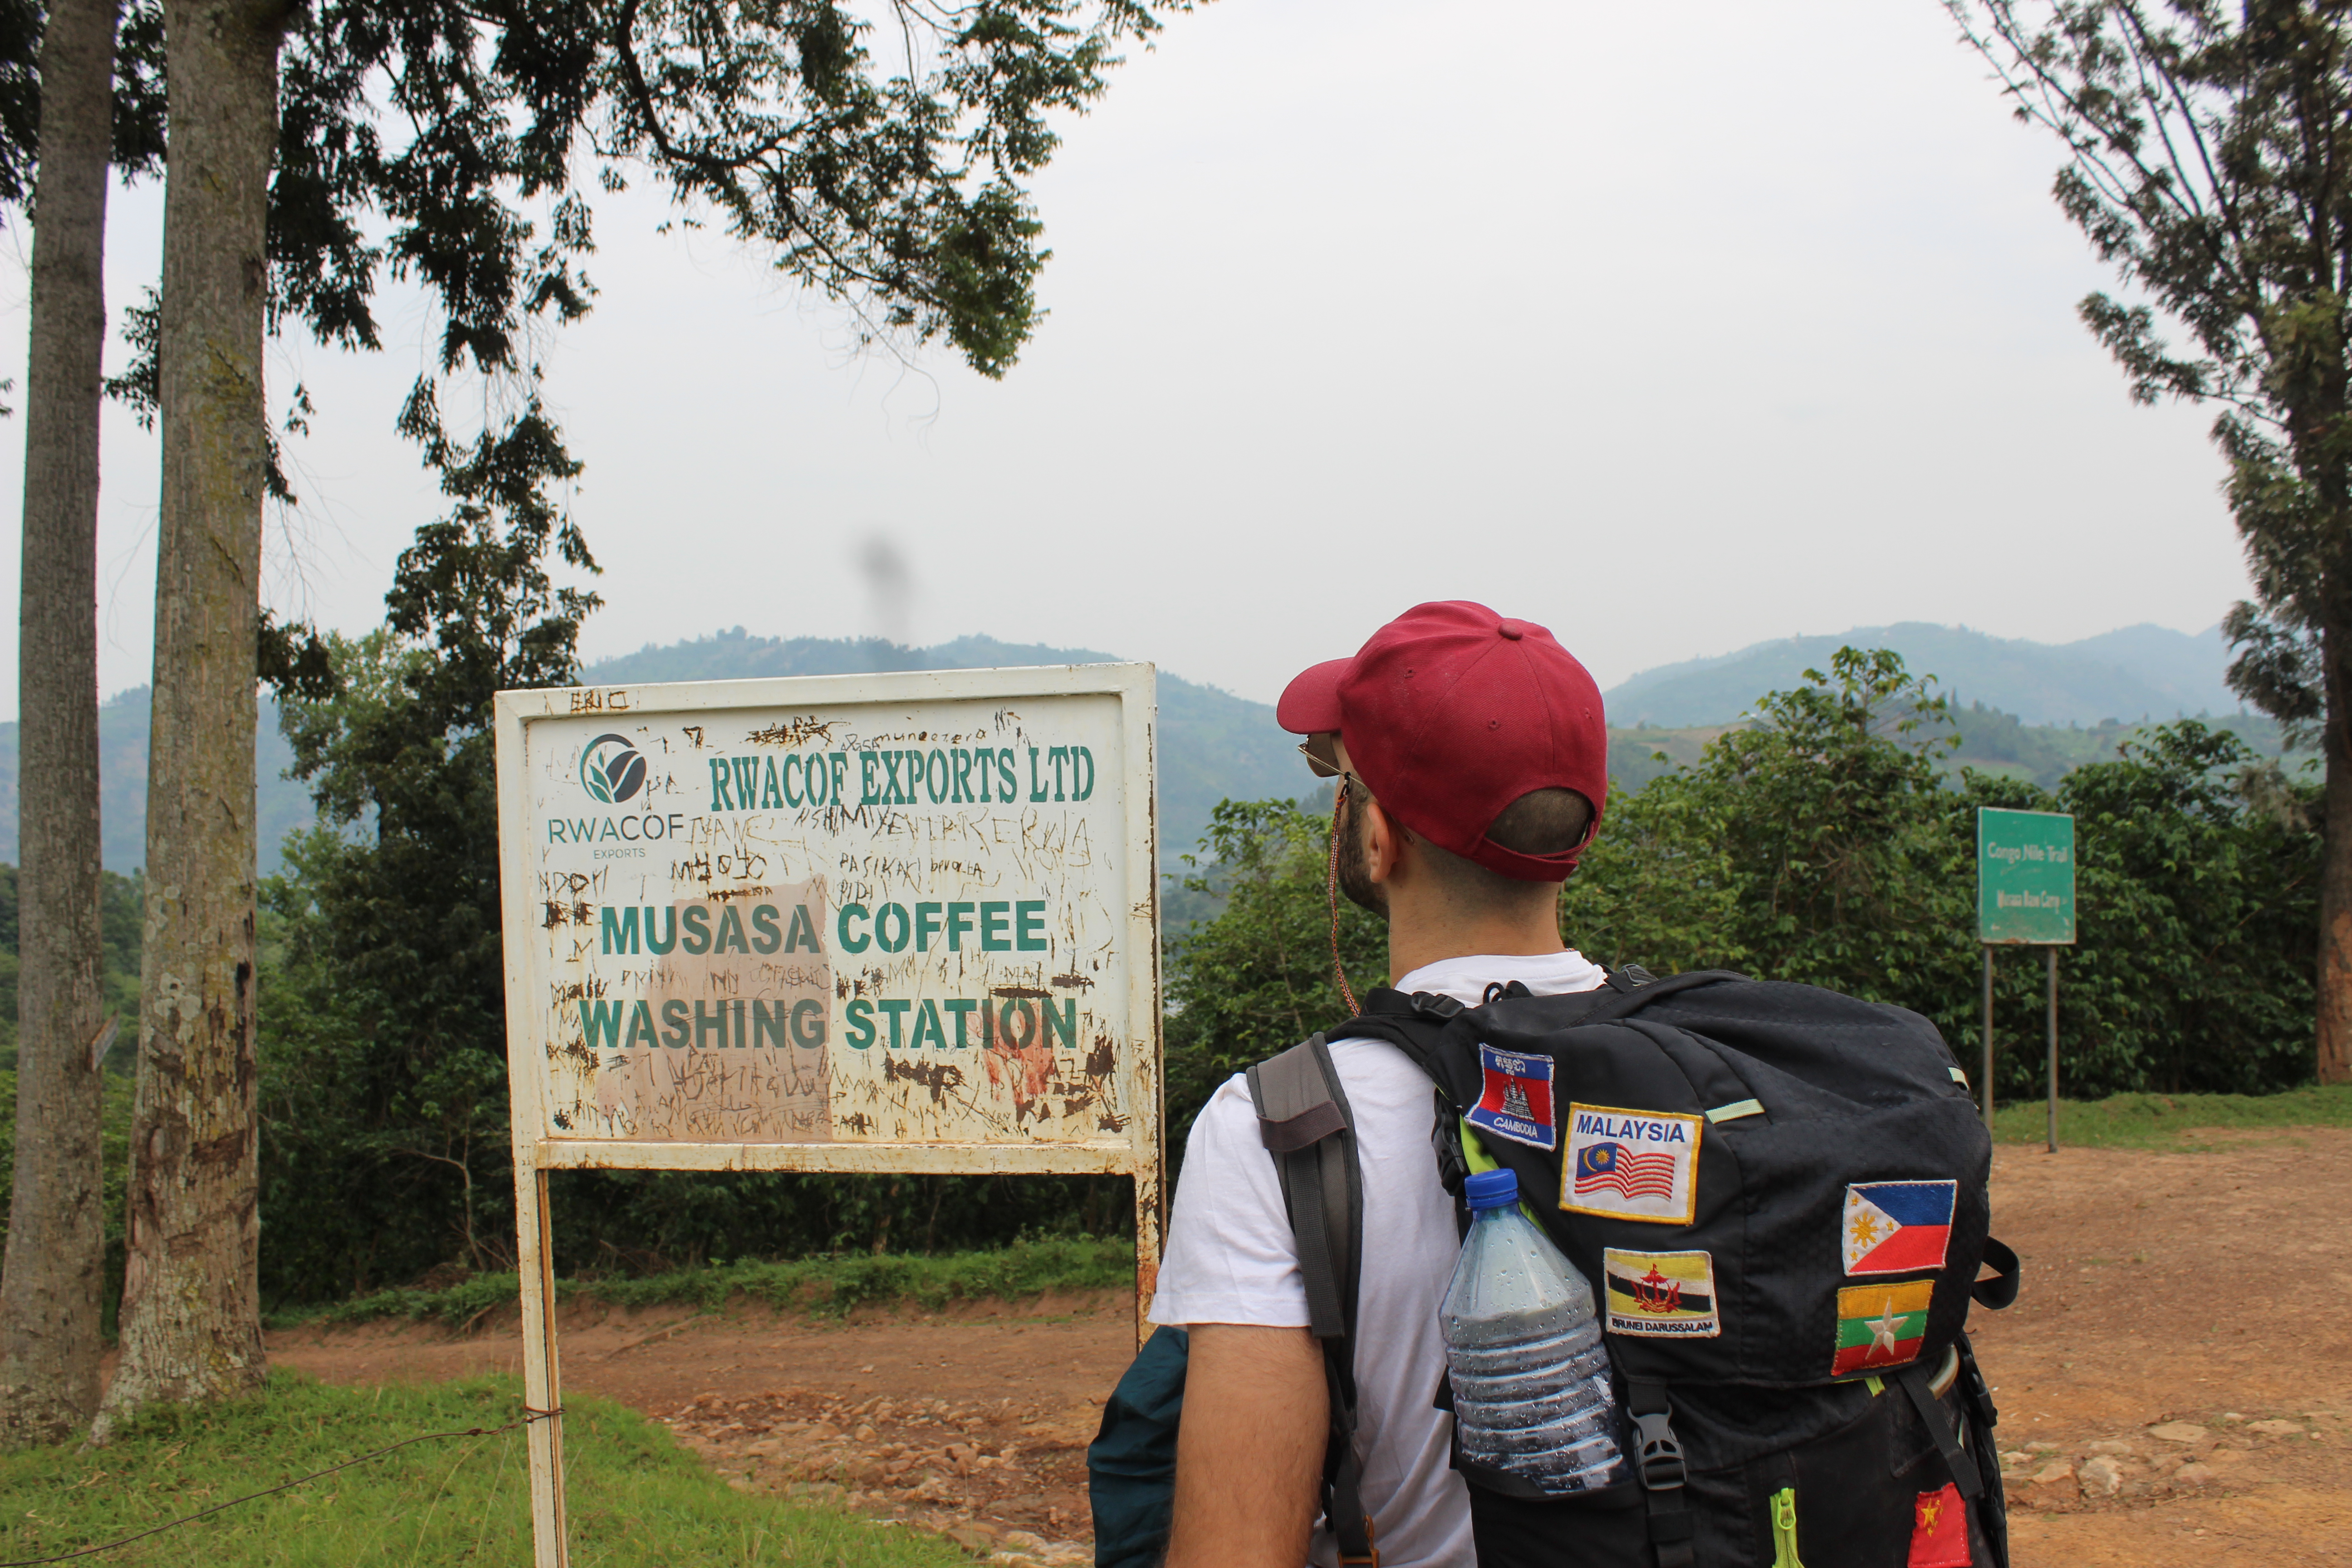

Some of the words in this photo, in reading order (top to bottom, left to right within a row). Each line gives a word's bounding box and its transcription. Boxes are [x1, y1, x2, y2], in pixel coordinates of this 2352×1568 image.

[708, 752, 848, 811] RWACOF
[859, 746, 1017, 805] EXPORTS
[1028, 745, 1094, 802] LTD
[548, 814, 684, 844] RWACOF
[594, 848, 646, 860] EXPORTS
[1987, 842, 2021, 864] Congo
[602, 905, 821, 955] MUSASA
[838, 901, 1047, 953] COFFEE
[578, 999, 825, 1049] WASHING
[845, 998, 1077, 1049] STATION
[1494, 1117, 1538, 1138] CAMBODIA
[1576, 1114, 1686, 1142] MALAYSIA
[1612, 1318, 1643, 1330] BRUNEI
[1645, 1321, 1713, 1332] DARUSSALAM
